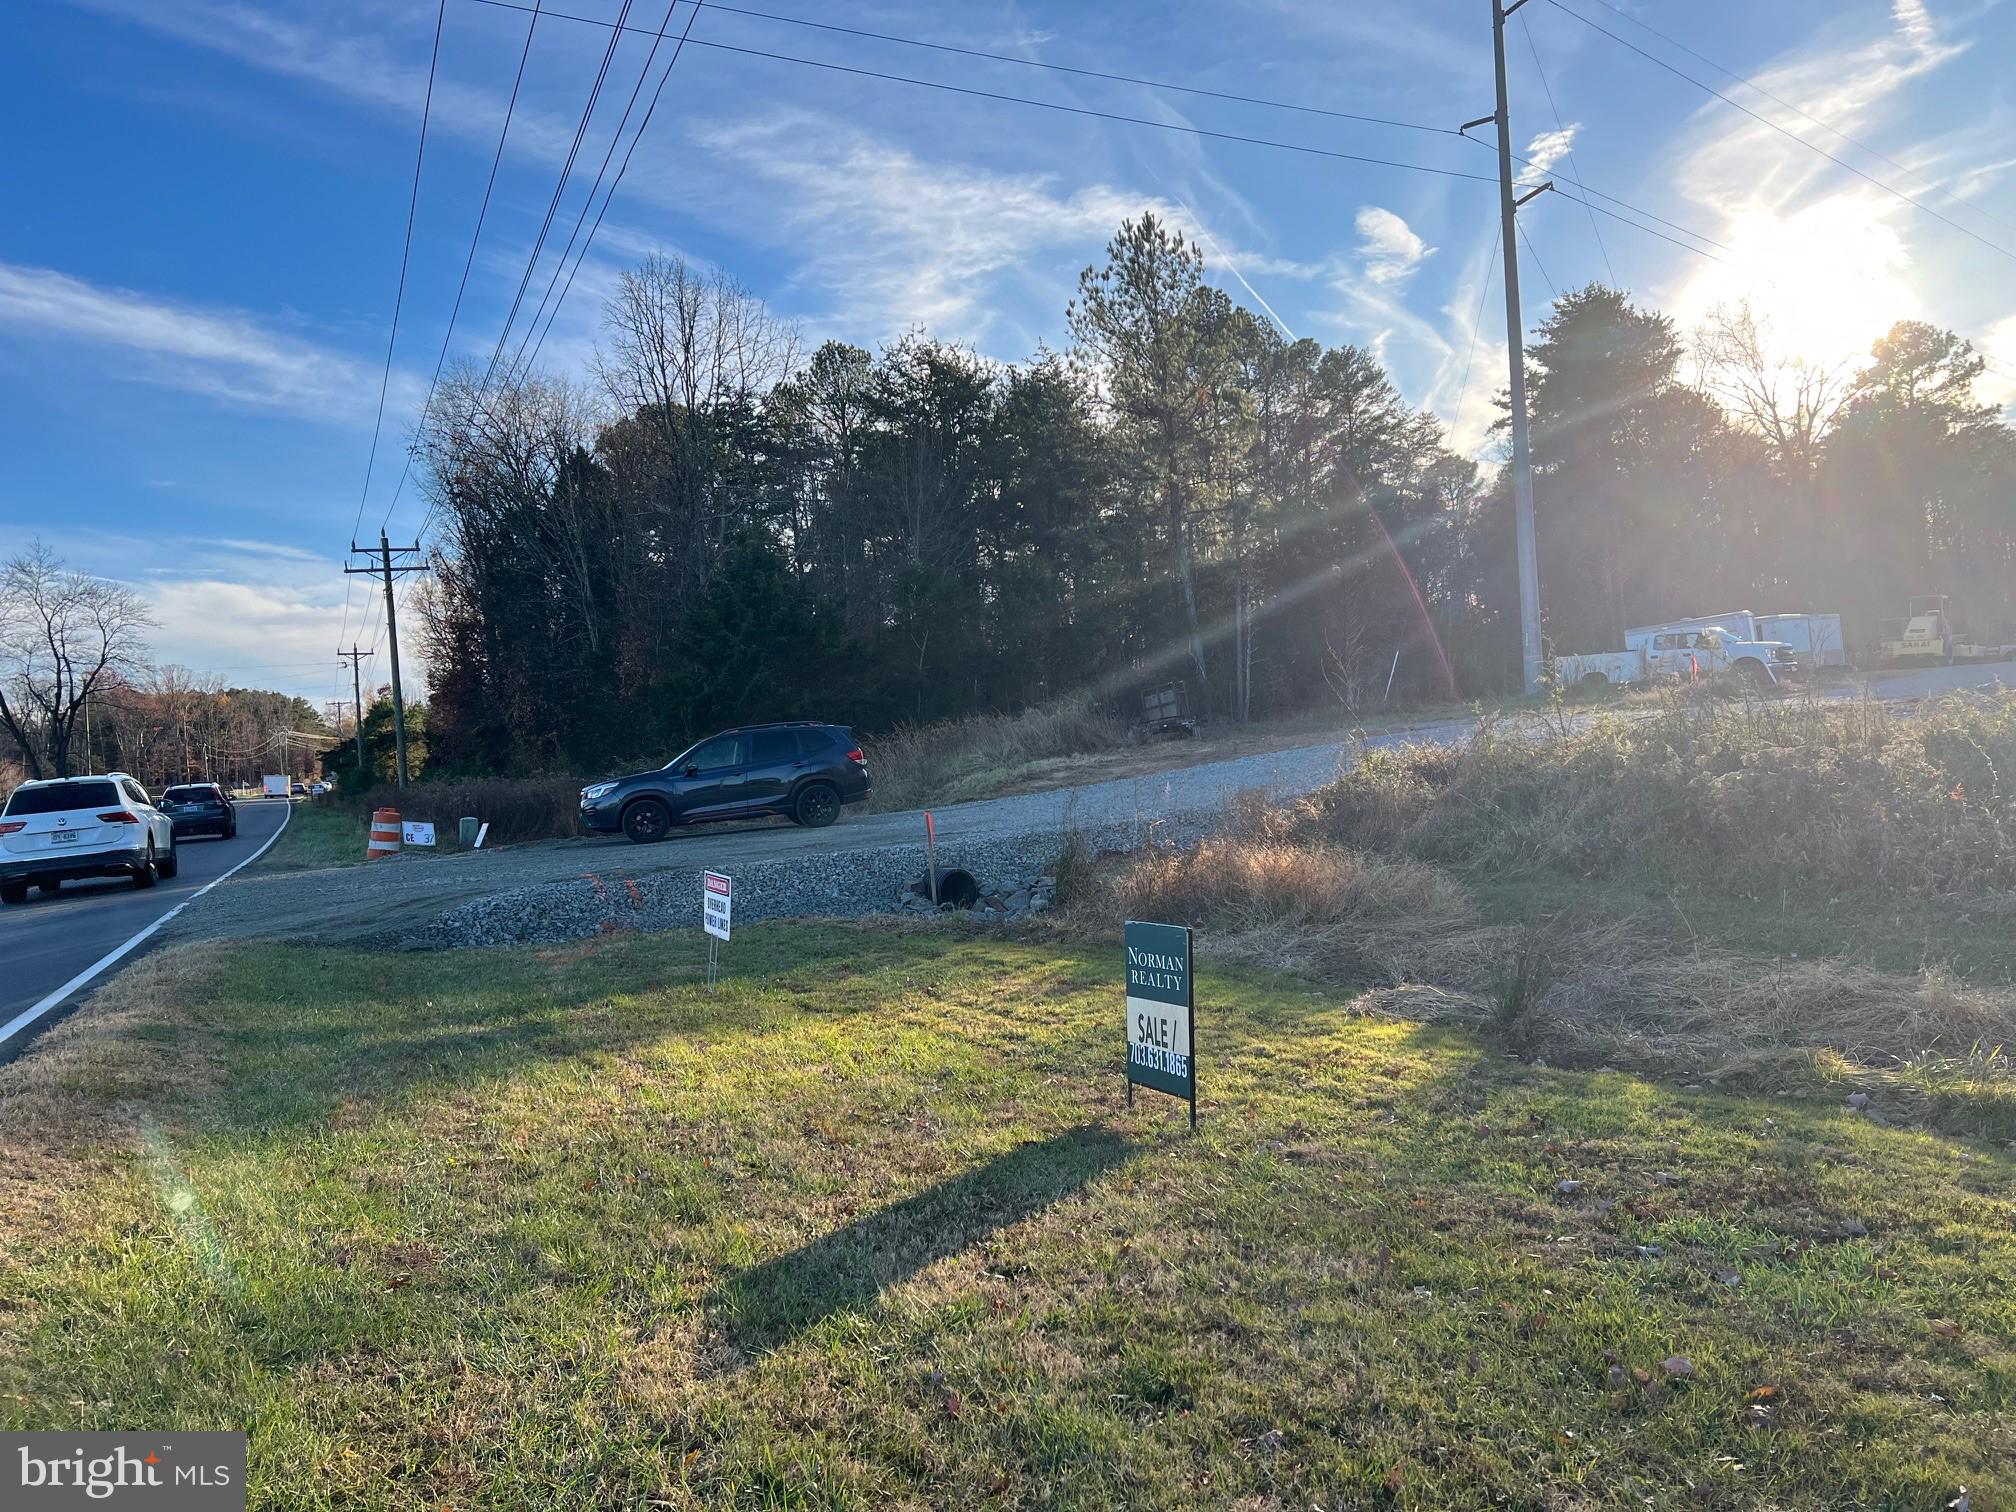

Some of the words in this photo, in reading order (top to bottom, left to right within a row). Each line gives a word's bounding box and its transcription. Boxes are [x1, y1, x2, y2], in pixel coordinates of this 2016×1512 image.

[717, 916, 729, 932] LINES
[1131, 969, 1182, 991] REALTY
[1138, 1013, 1168, 1049] SALE
[1129, 1042, 1187, 1078] 703.631.1865
